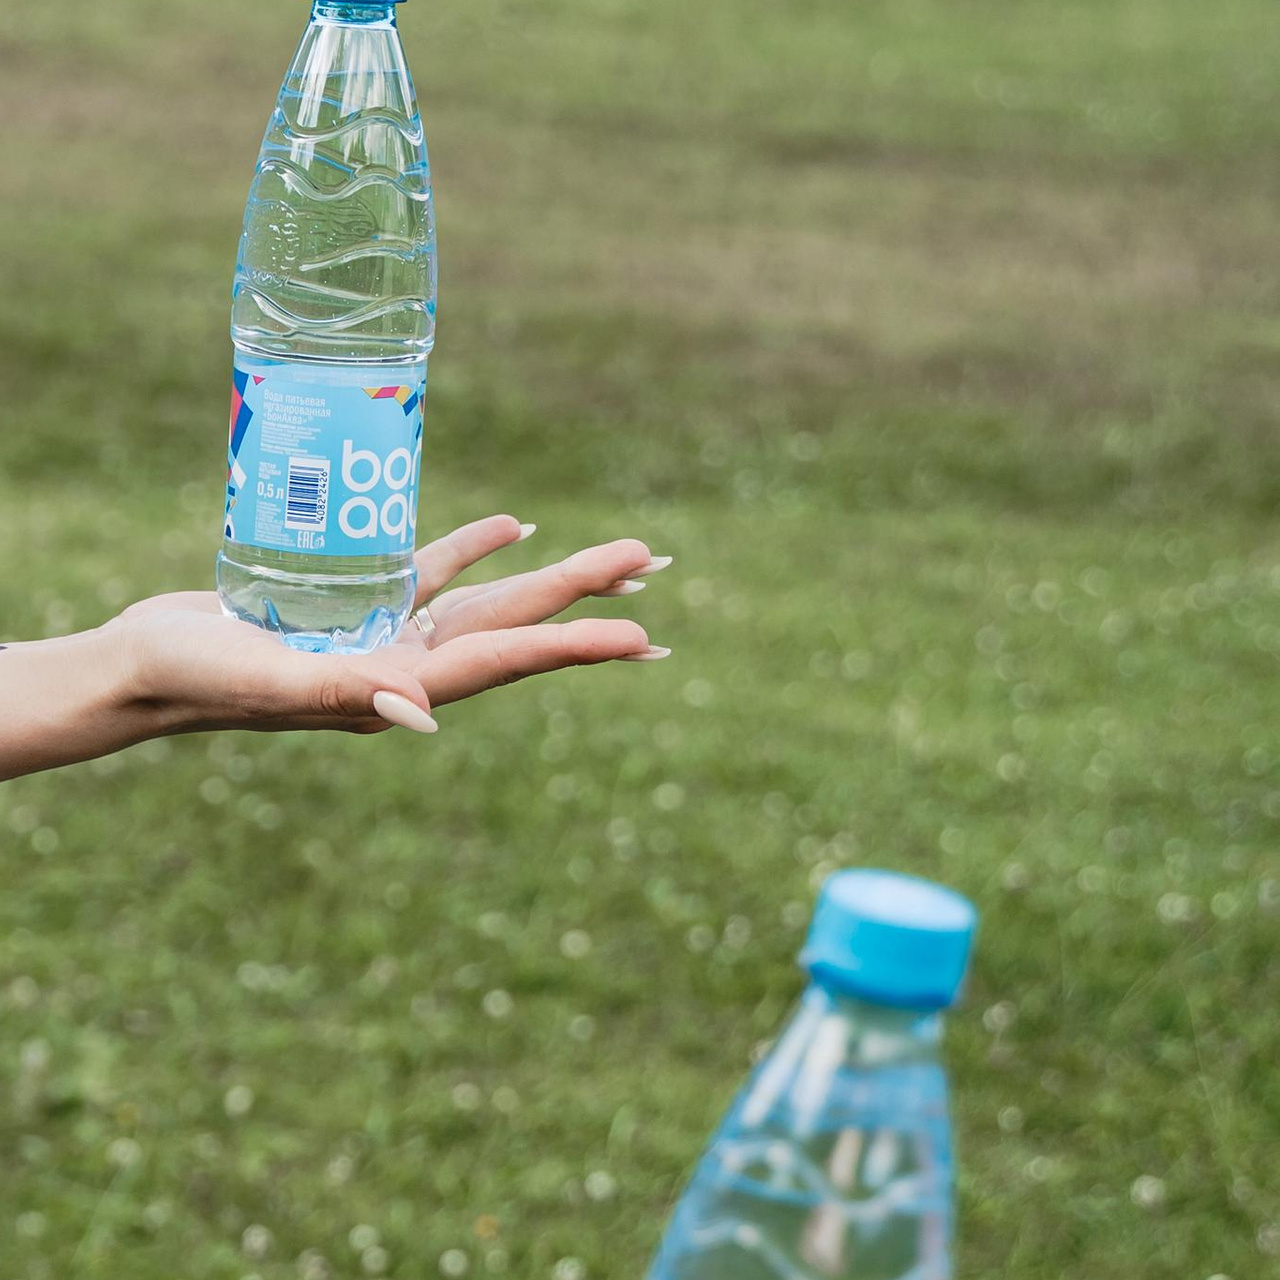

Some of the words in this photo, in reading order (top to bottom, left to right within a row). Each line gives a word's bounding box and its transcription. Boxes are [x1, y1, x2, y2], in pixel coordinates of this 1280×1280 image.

[264, 389, 283, 402] Вода
[257, 481, 274, 498] 0,5
[276, 488, 284, 500] л
